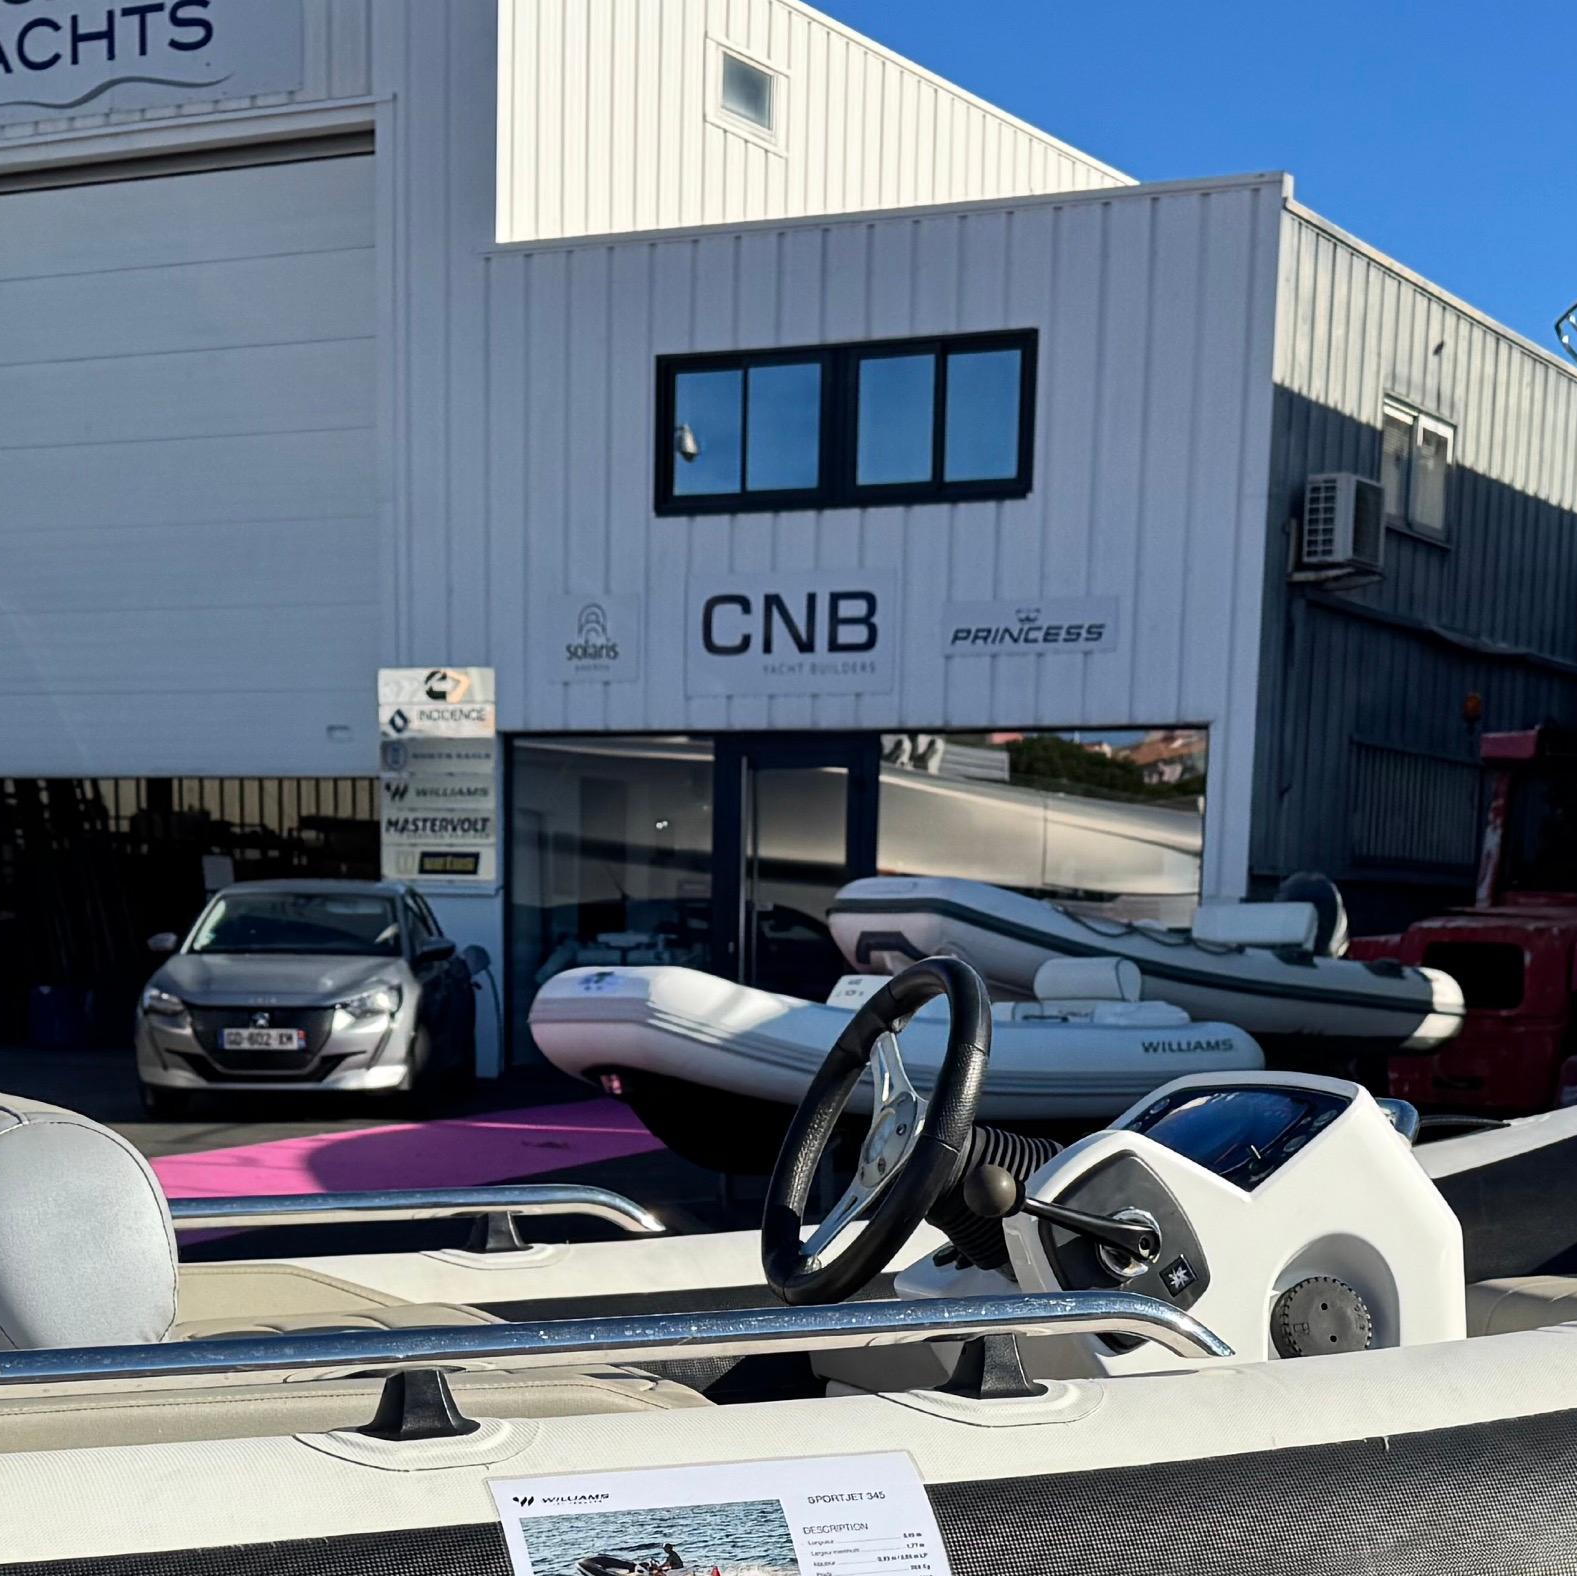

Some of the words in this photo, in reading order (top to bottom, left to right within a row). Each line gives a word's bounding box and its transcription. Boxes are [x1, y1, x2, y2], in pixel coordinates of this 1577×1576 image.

[702, 590, 878, 656] CNB
[950, 623, 1107, 646] PRINCESS
[566, 637, 619, 661] solaris
[415, 786, 489, 798] WILLIAMS
[384, 817, 491, 834] MASTERVOLT
[1141, 1039, 1235, 1054] WILLIAMS
[802, 1522, 869, 1535] DESCRIPTION
